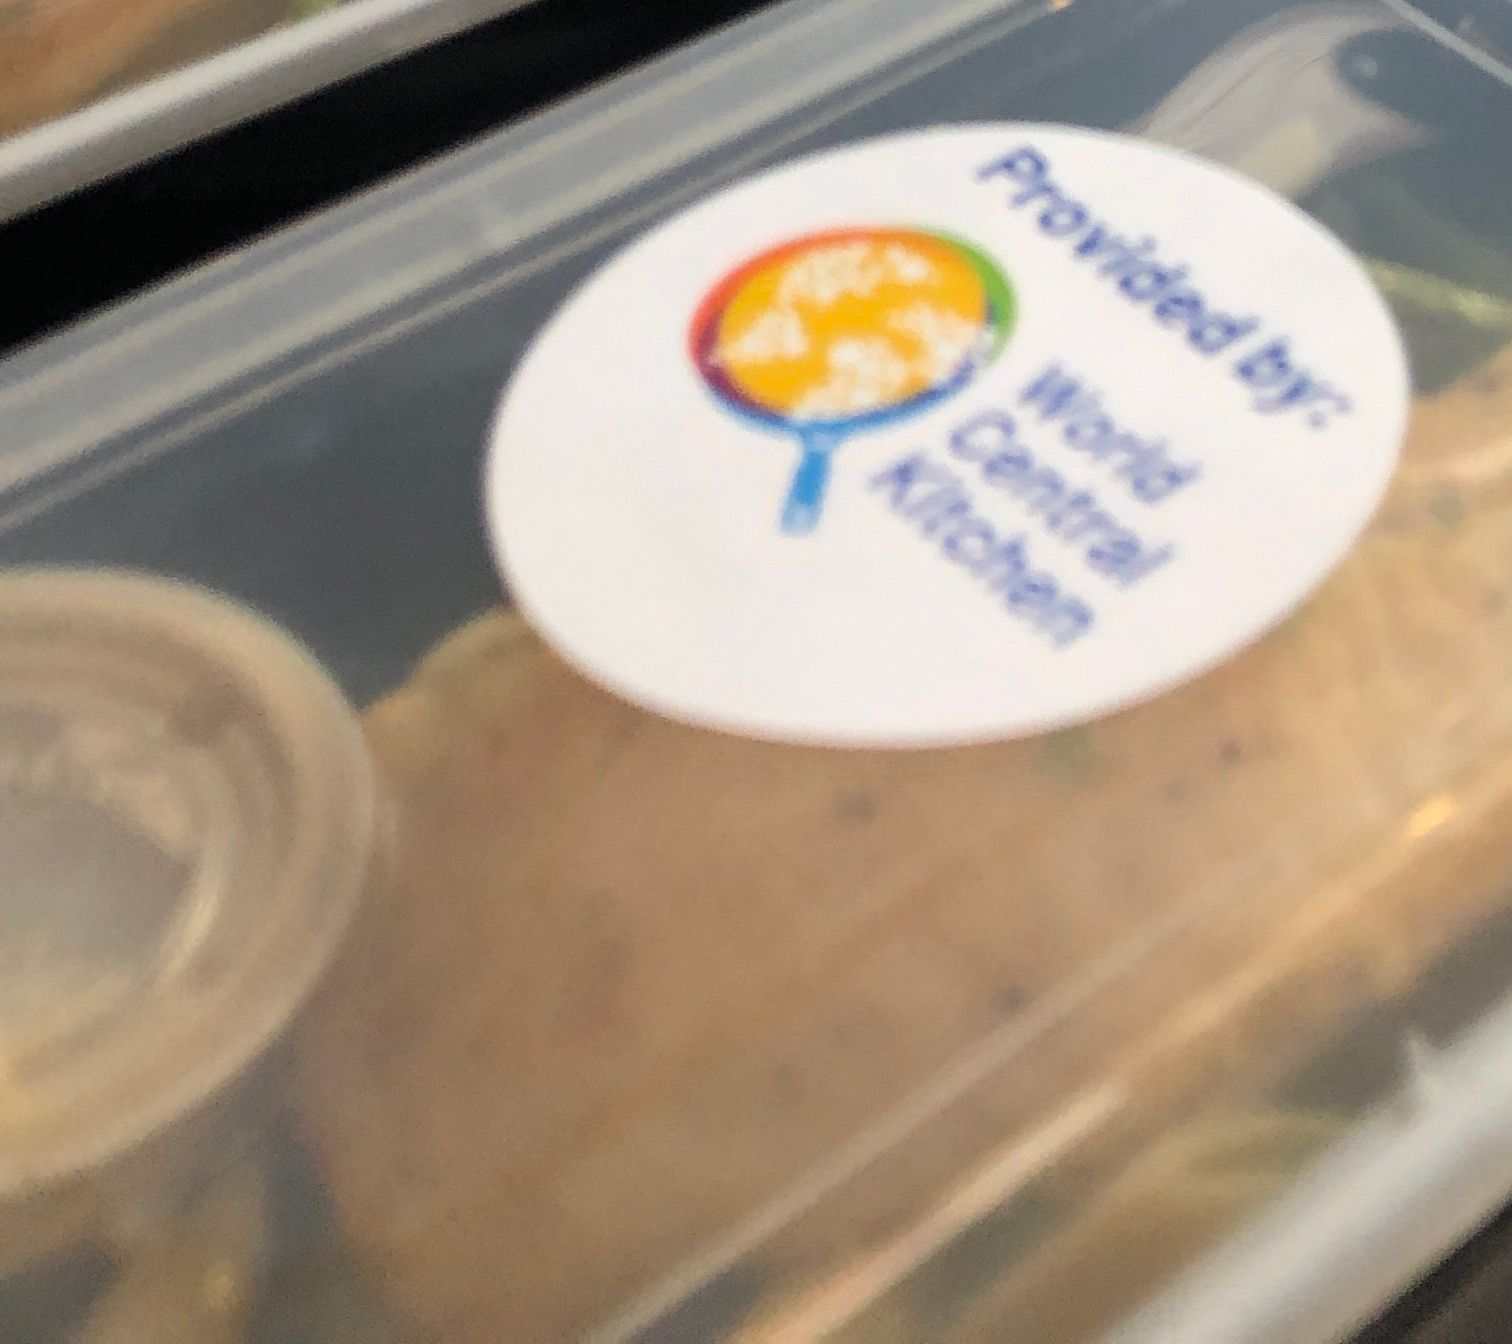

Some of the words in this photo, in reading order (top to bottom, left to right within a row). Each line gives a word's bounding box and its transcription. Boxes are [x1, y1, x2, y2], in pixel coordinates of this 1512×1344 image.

[975, 143, 1259, 359] Provided
[1231, 334, 1353, 430] by:
[946, 408, 1177, 590] Central
[1020, 360, 1205, 505] World
[868, 450, 1098, 649] Kitchen
